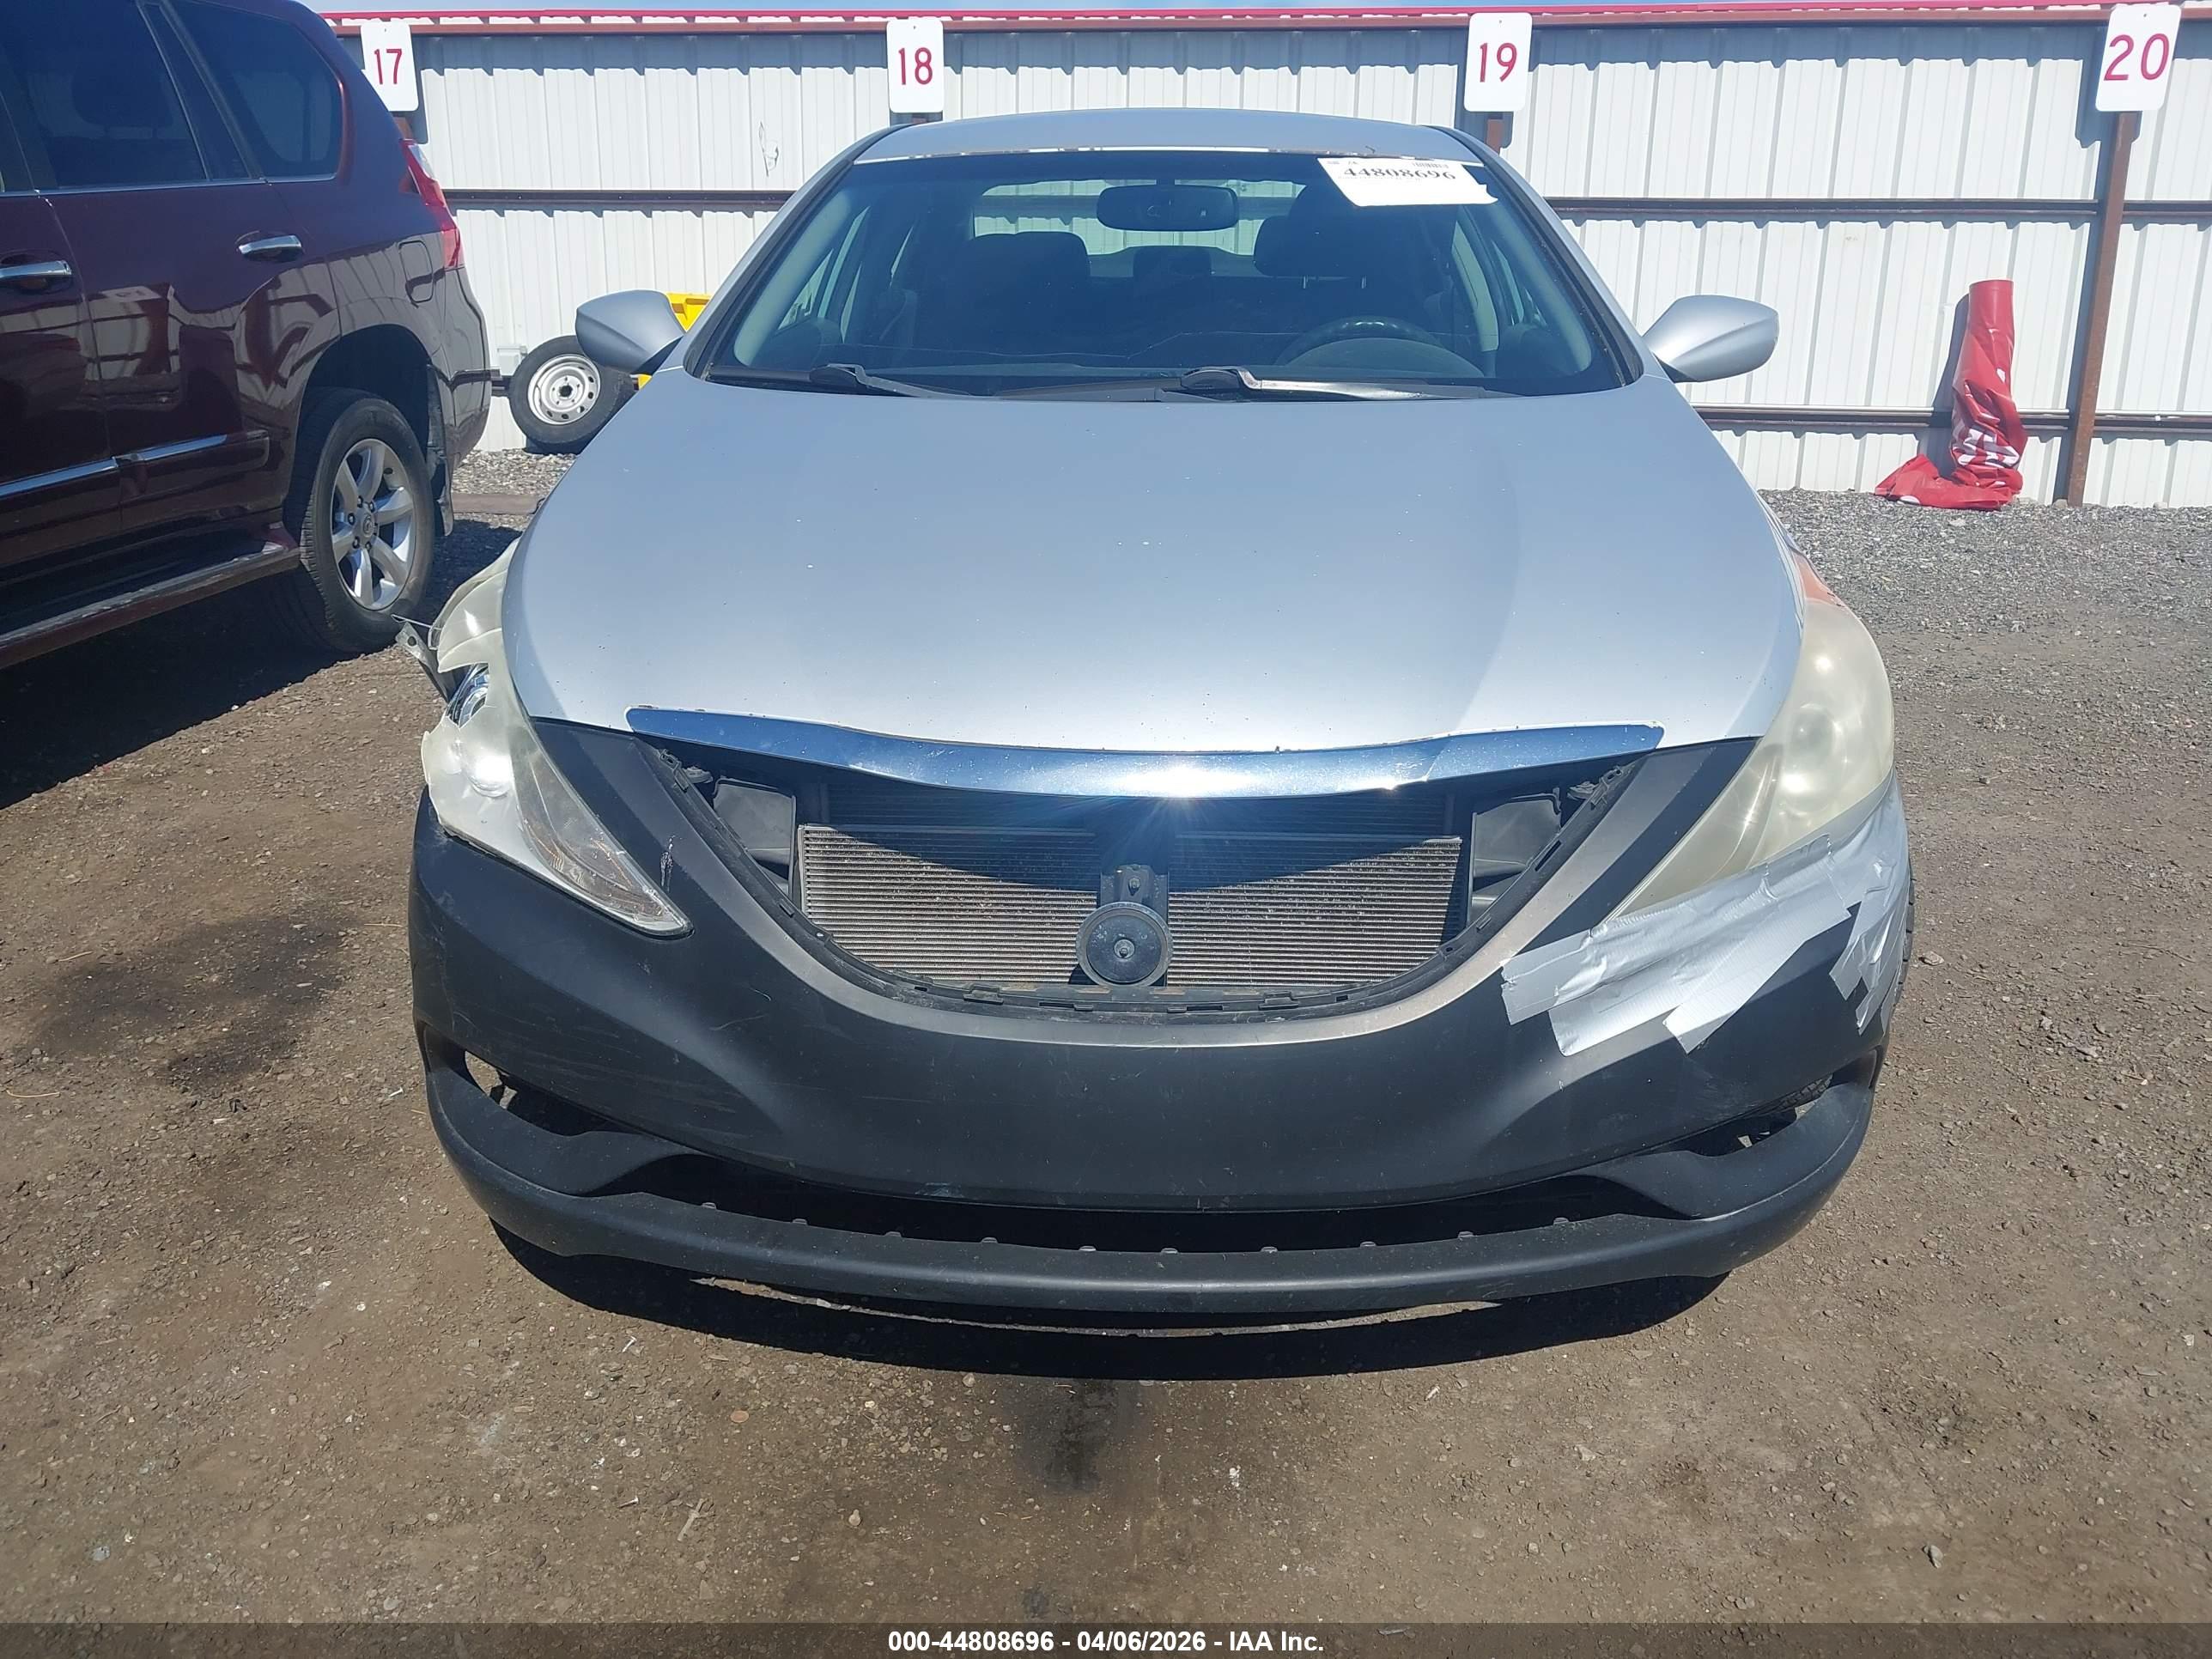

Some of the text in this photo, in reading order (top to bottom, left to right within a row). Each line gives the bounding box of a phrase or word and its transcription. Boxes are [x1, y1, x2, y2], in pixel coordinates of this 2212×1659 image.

[374, 48, 403, 84] 17
[898, 47, 933, 85] 18
[1480, 42, 1518, 82] 19
[2104, 33, 2170, 82] 20
[1344, 167, 1456, 179] 44808696
